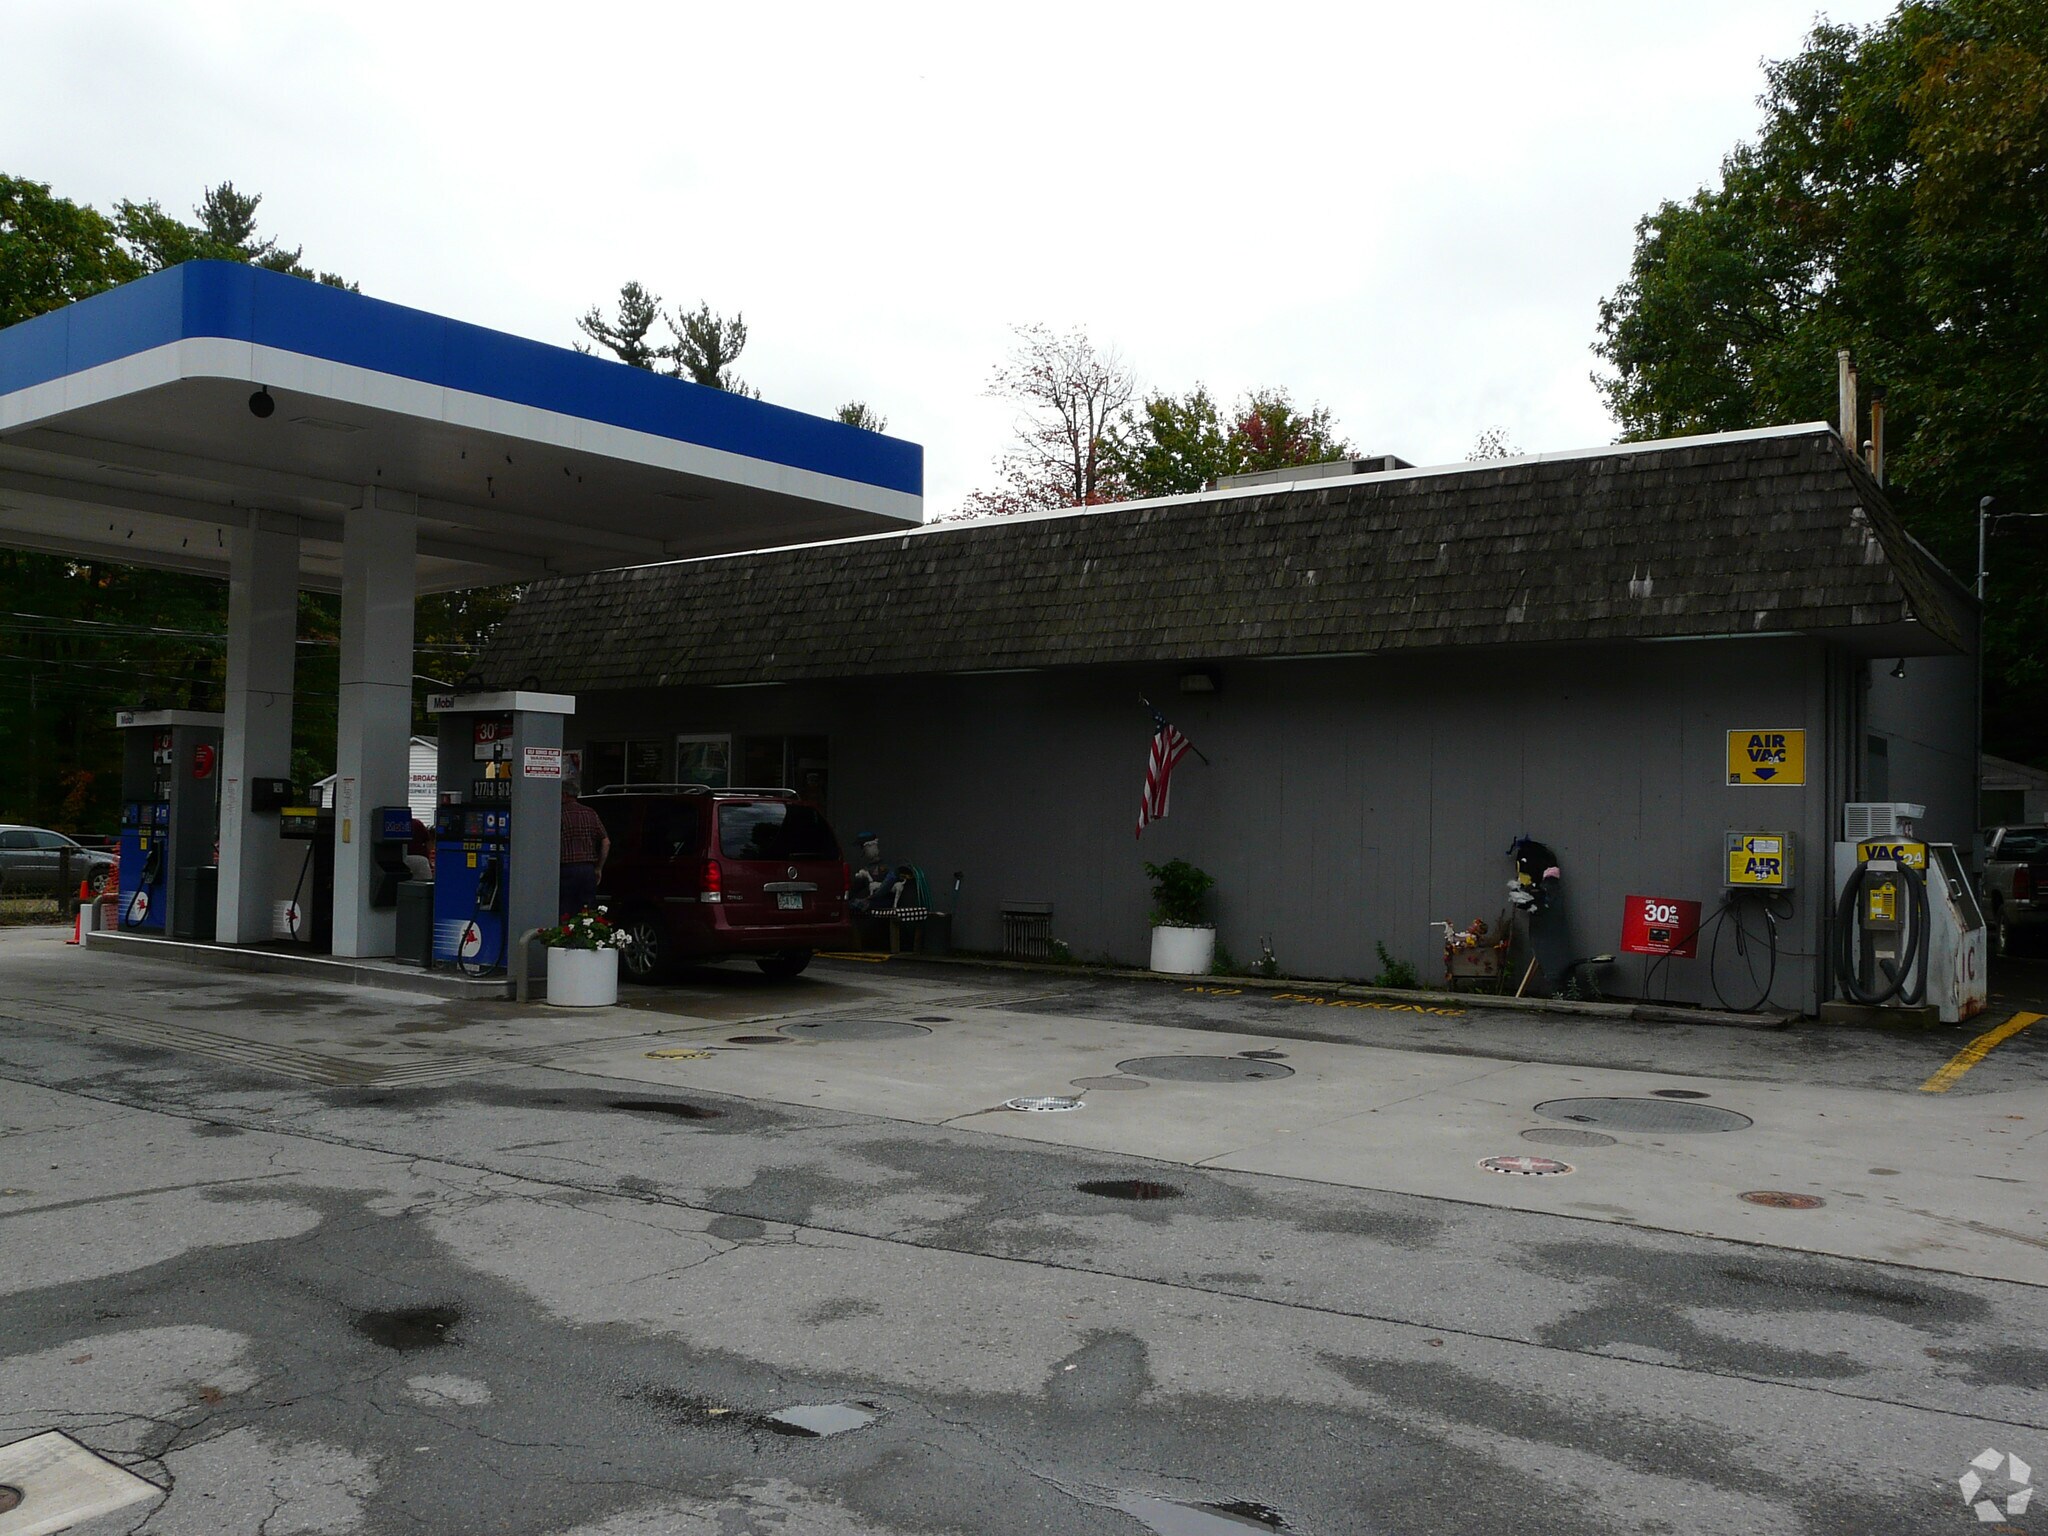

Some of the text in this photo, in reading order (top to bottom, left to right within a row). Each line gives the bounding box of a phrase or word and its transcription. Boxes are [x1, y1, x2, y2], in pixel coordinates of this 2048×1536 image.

[433, 696, 455, 709] Mobil
[1747, 734, 1786, 748] AIR
[1746, 748, 1786, 765] VAC 24
[384, 821, 412, 832] Mobil
[1864, 845, 1923, 866] VAC 24
[1744, 857, 1780, 875] AIR
[1755, 871, 1769, 881] 24
[1643, 904, 1678, 923] 30¢
[1270, 993, 1467, 1017] PARKING
